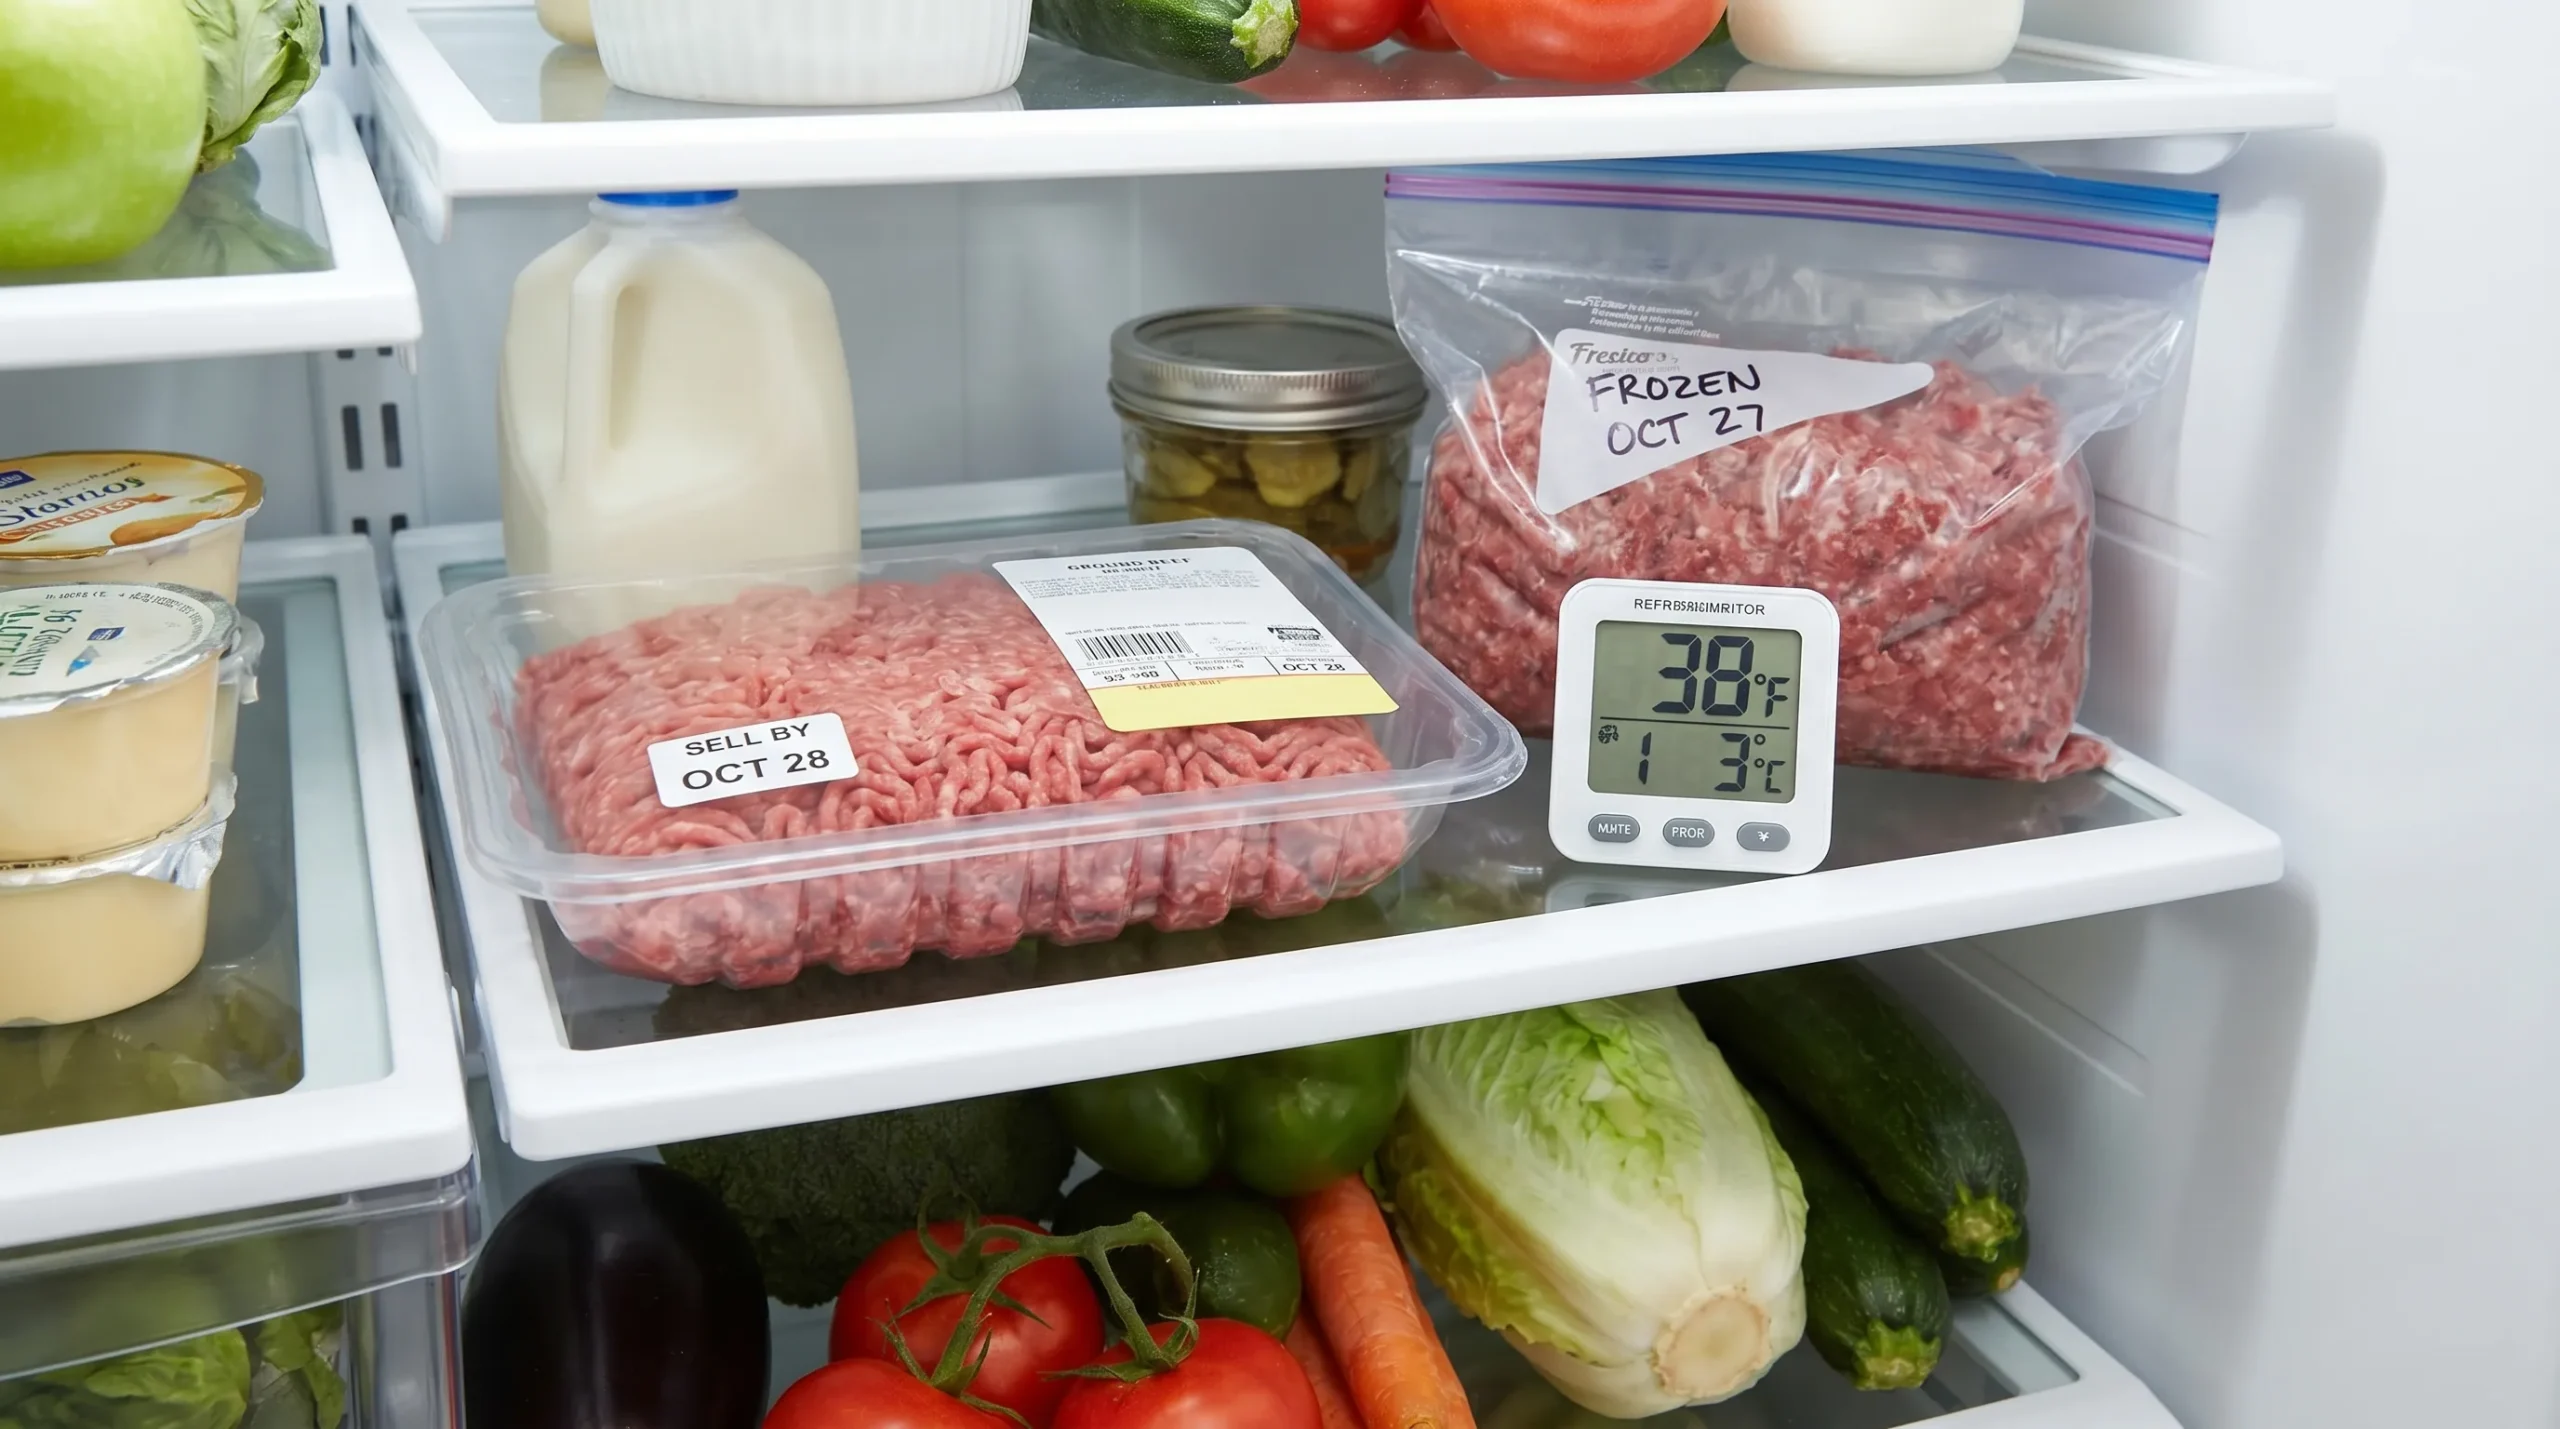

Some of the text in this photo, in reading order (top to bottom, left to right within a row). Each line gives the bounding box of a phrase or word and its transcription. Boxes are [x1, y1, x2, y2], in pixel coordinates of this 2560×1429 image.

[1586, 364, 1761, 412] FROZEN
[1607, 404, 1764, 456] OCT 27
[1282, 663, 1319, 672] OCT
[685, 723, 810, 756] SELL BY
[682, 749, 830, 790] OCT 28
